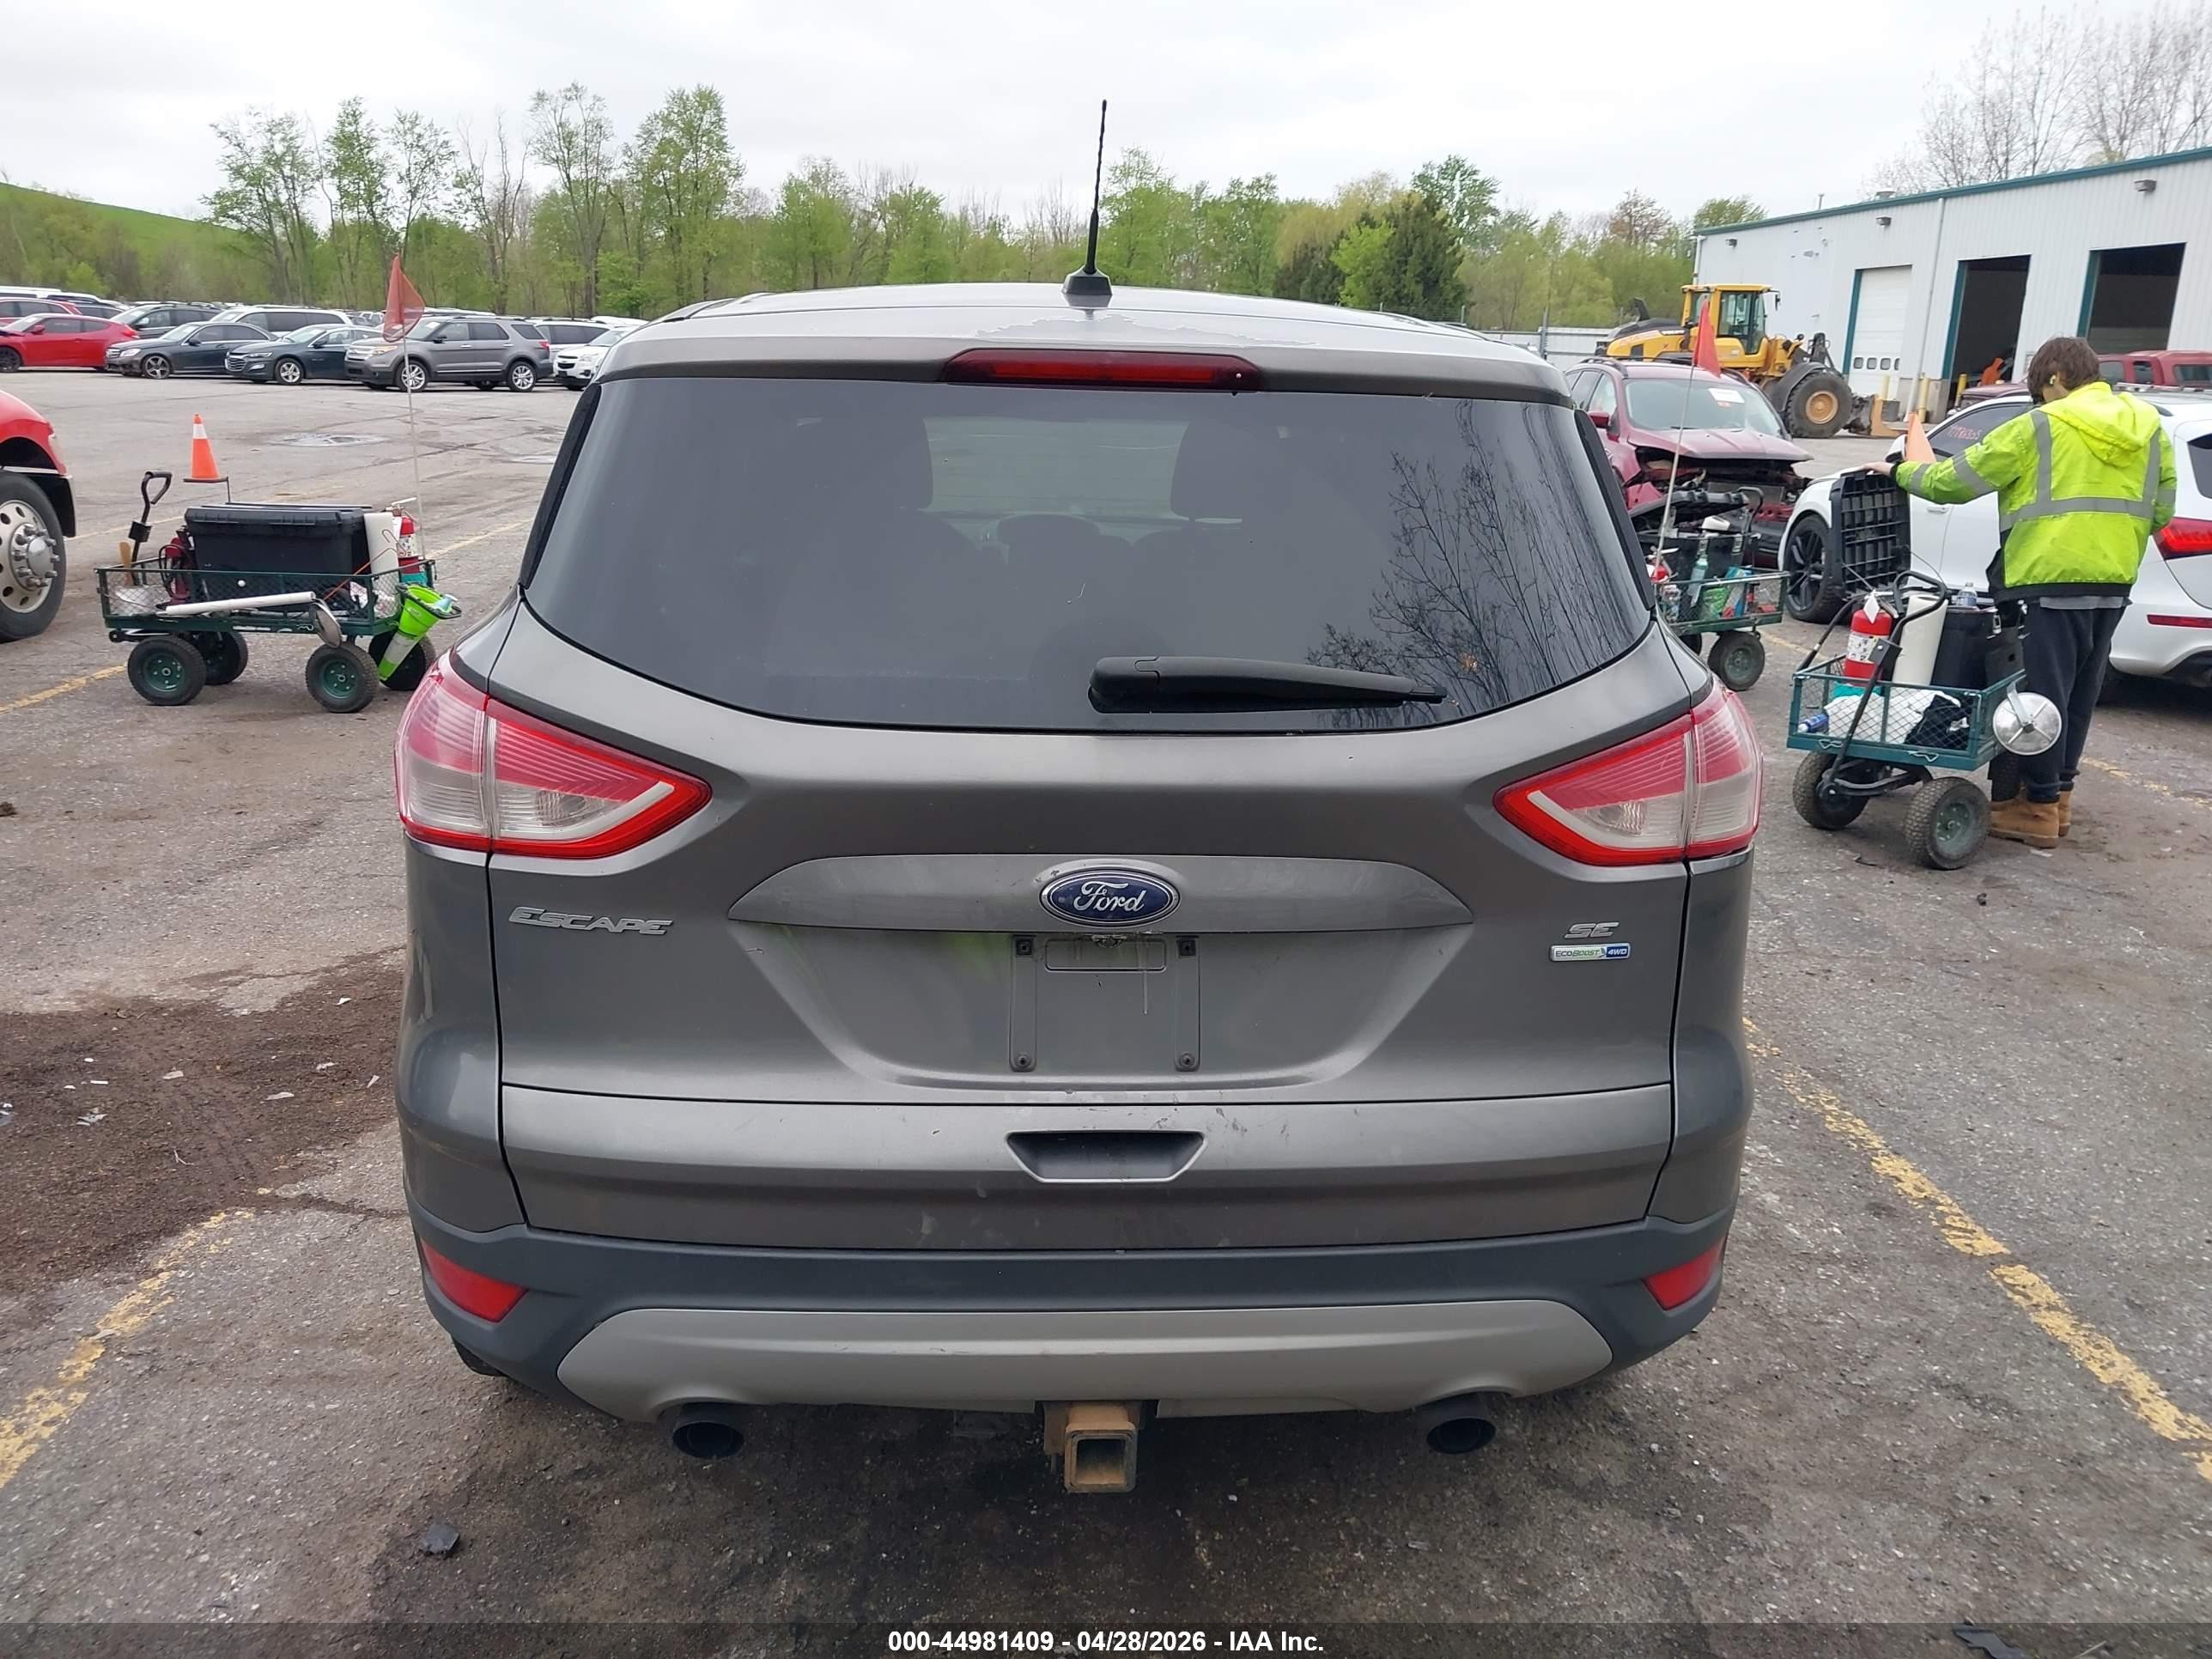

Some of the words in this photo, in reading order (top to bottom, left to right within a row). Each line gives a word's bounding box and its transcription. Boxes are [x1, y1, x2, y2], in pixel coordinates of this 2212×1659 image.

[1073, 880, 1146, 912] Ford
[508, 906, 673, 936] ESCAPE
[1564, 921, 1620, 939] SE
[1555, 949, 1600, 957] ECOBOOST
